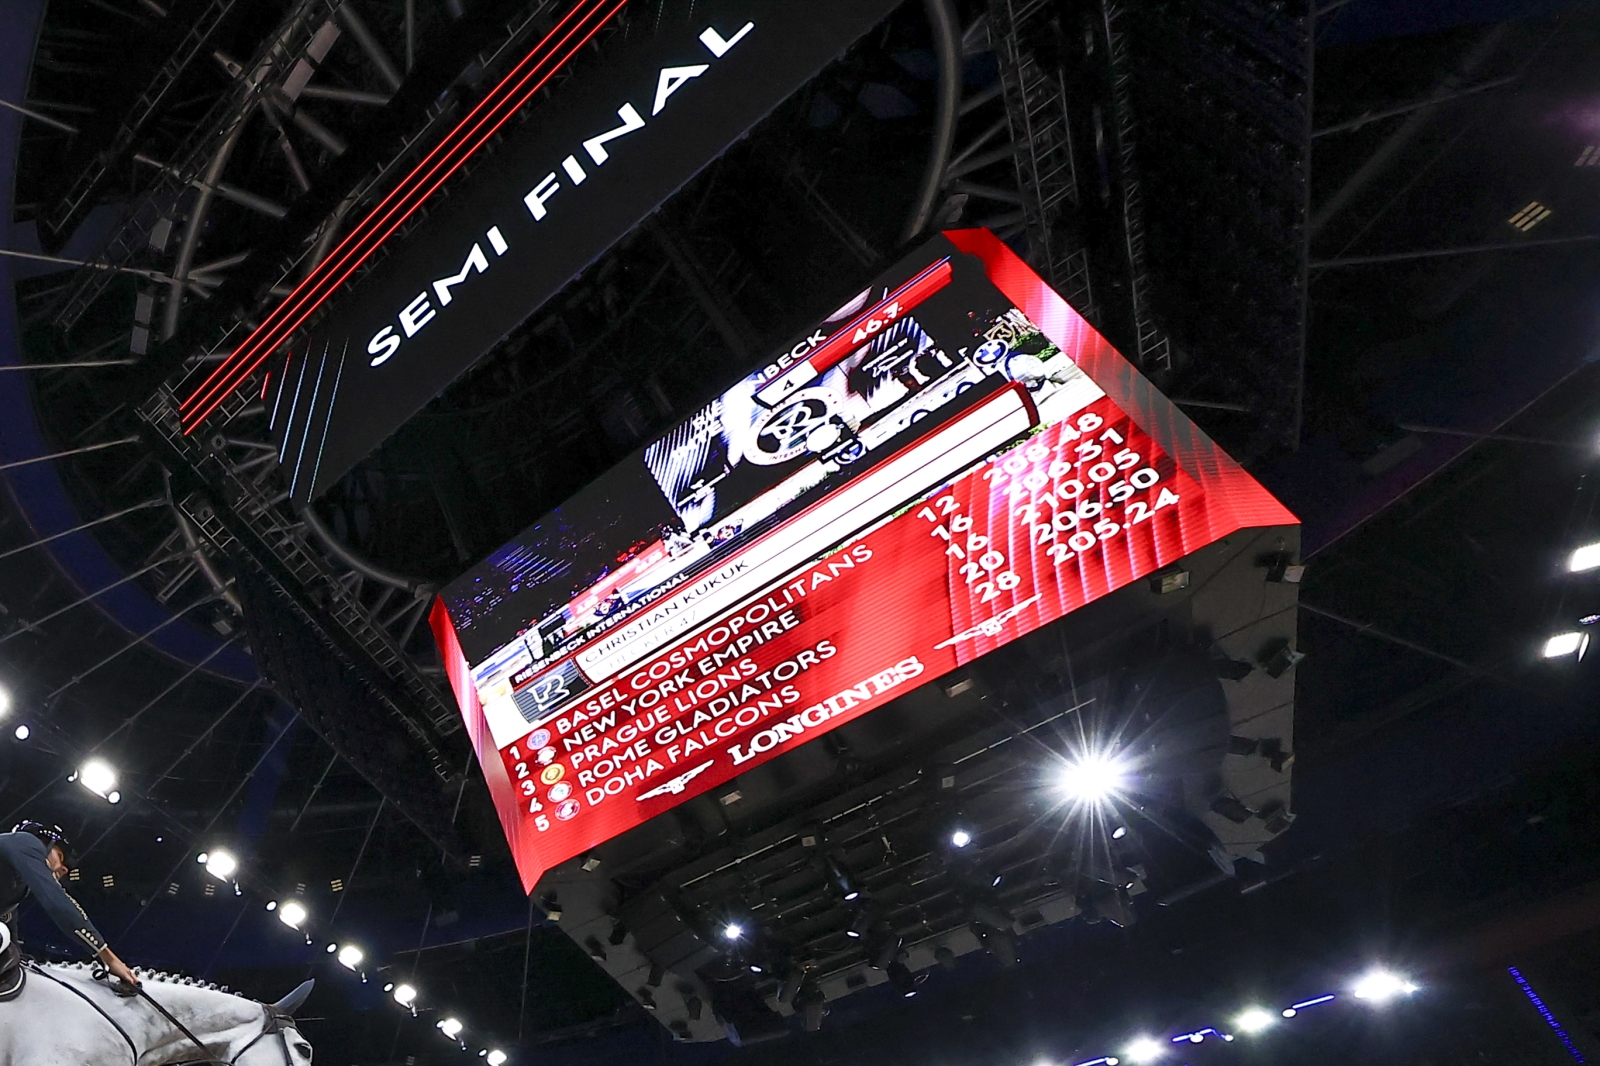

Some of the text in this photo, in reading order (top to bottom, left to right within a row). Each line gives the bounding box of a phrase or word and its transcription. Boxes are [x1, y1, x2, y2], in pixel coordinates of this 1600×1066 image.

[367, 22, 754, 366] SEMI FINAL
[510, 746, 520, 760] 1
[556, 687, 628, 735] BASEL
[631, 546, 872, 690] COSMOPOLITANS
[917, 495, 960, 523] 12
[983, 412, 1103, 488] 208.48
[515, 428, 1123, 778] 2 NEW YORK EMPIRE 16 206.31
[515, 635, 586, 684] RIESENBECK
[587, 573, 689, 639] INTERNATIONAL
[522, 448, 1140, 796] 3 PRAGUE LIONS 16 210.05
[529, 467, 1159, 813] 4 ROME GLADIATORS 20 206.50
[535, 487, 1180, 831] 5 DOHA FALCONS 28 205.24
[585, 602, 679, 663] CHRISTIAN
[683, 560, 749, 603] KUKUK
[727, 656, 925, 765] LONGINES
